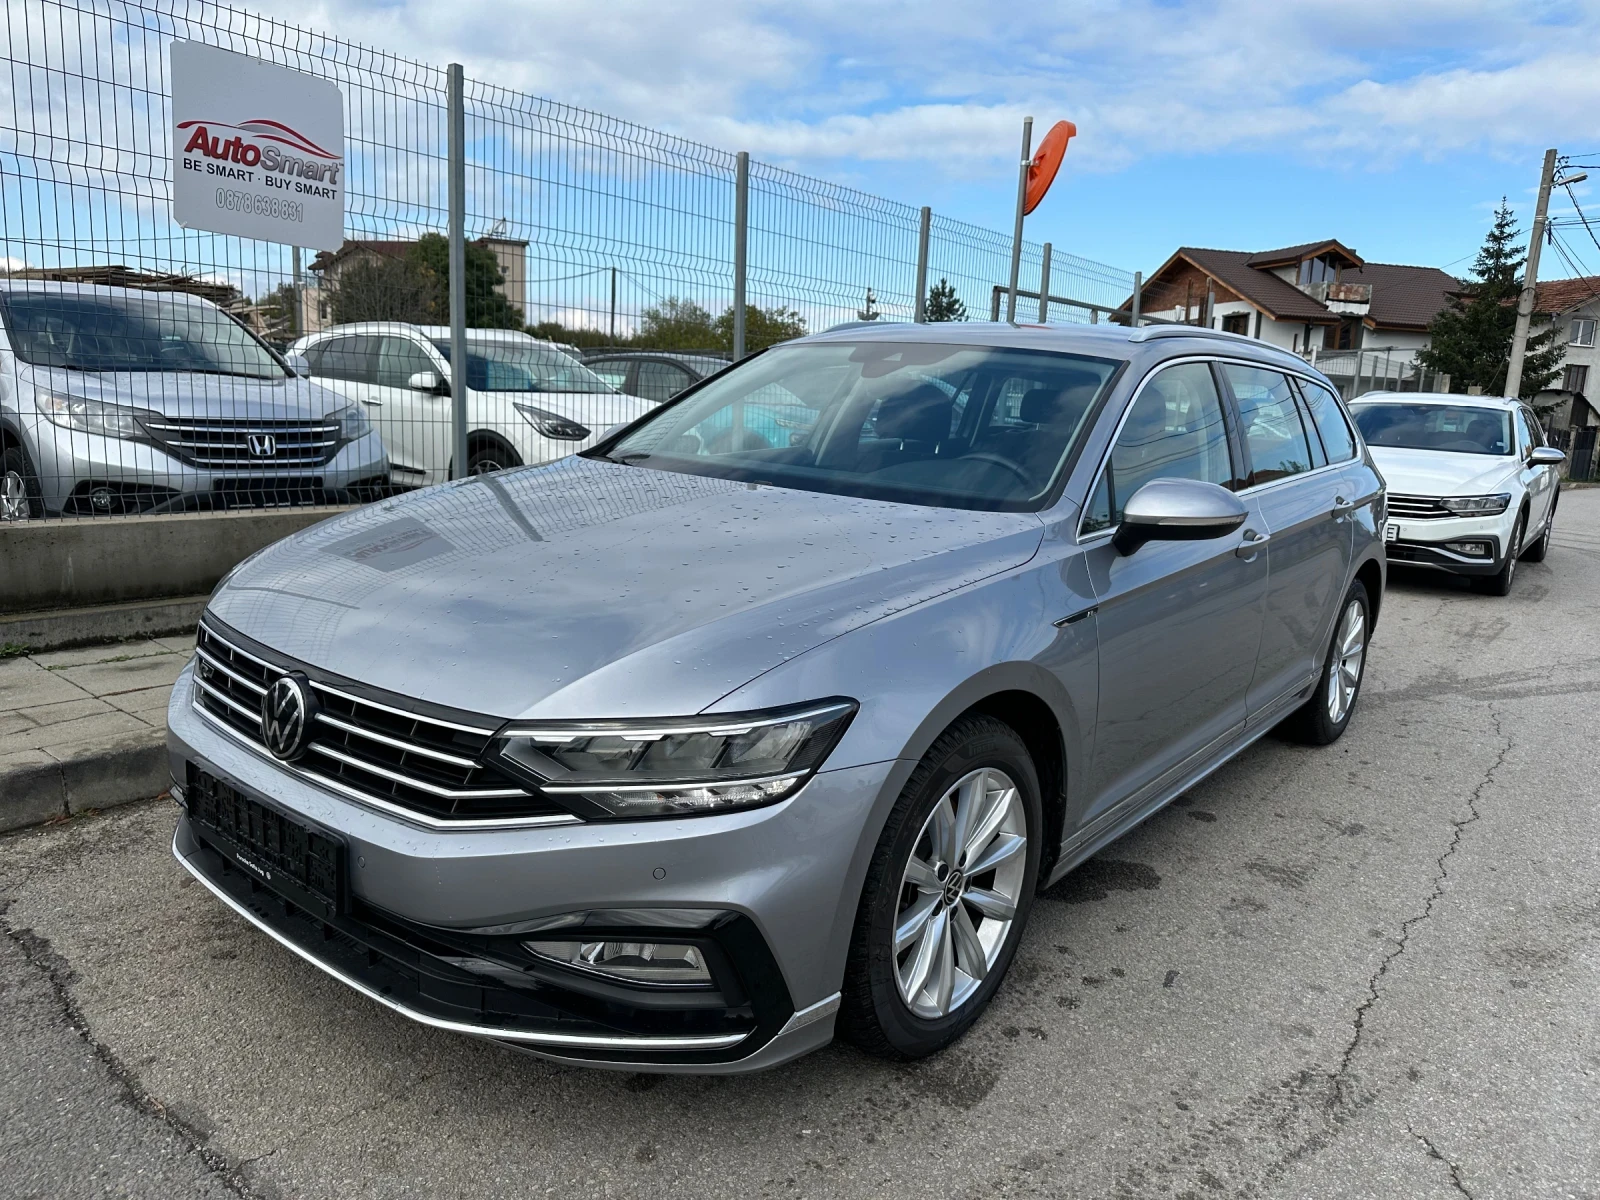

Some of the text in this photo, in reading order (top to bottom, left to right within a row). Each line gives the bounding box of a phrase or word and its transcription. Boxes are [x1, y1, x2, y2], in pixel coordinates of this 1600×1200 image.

[183, 158, 338, 200] BE SMART BUY SMART
[184, 126, 340, 184] AutoSmart
